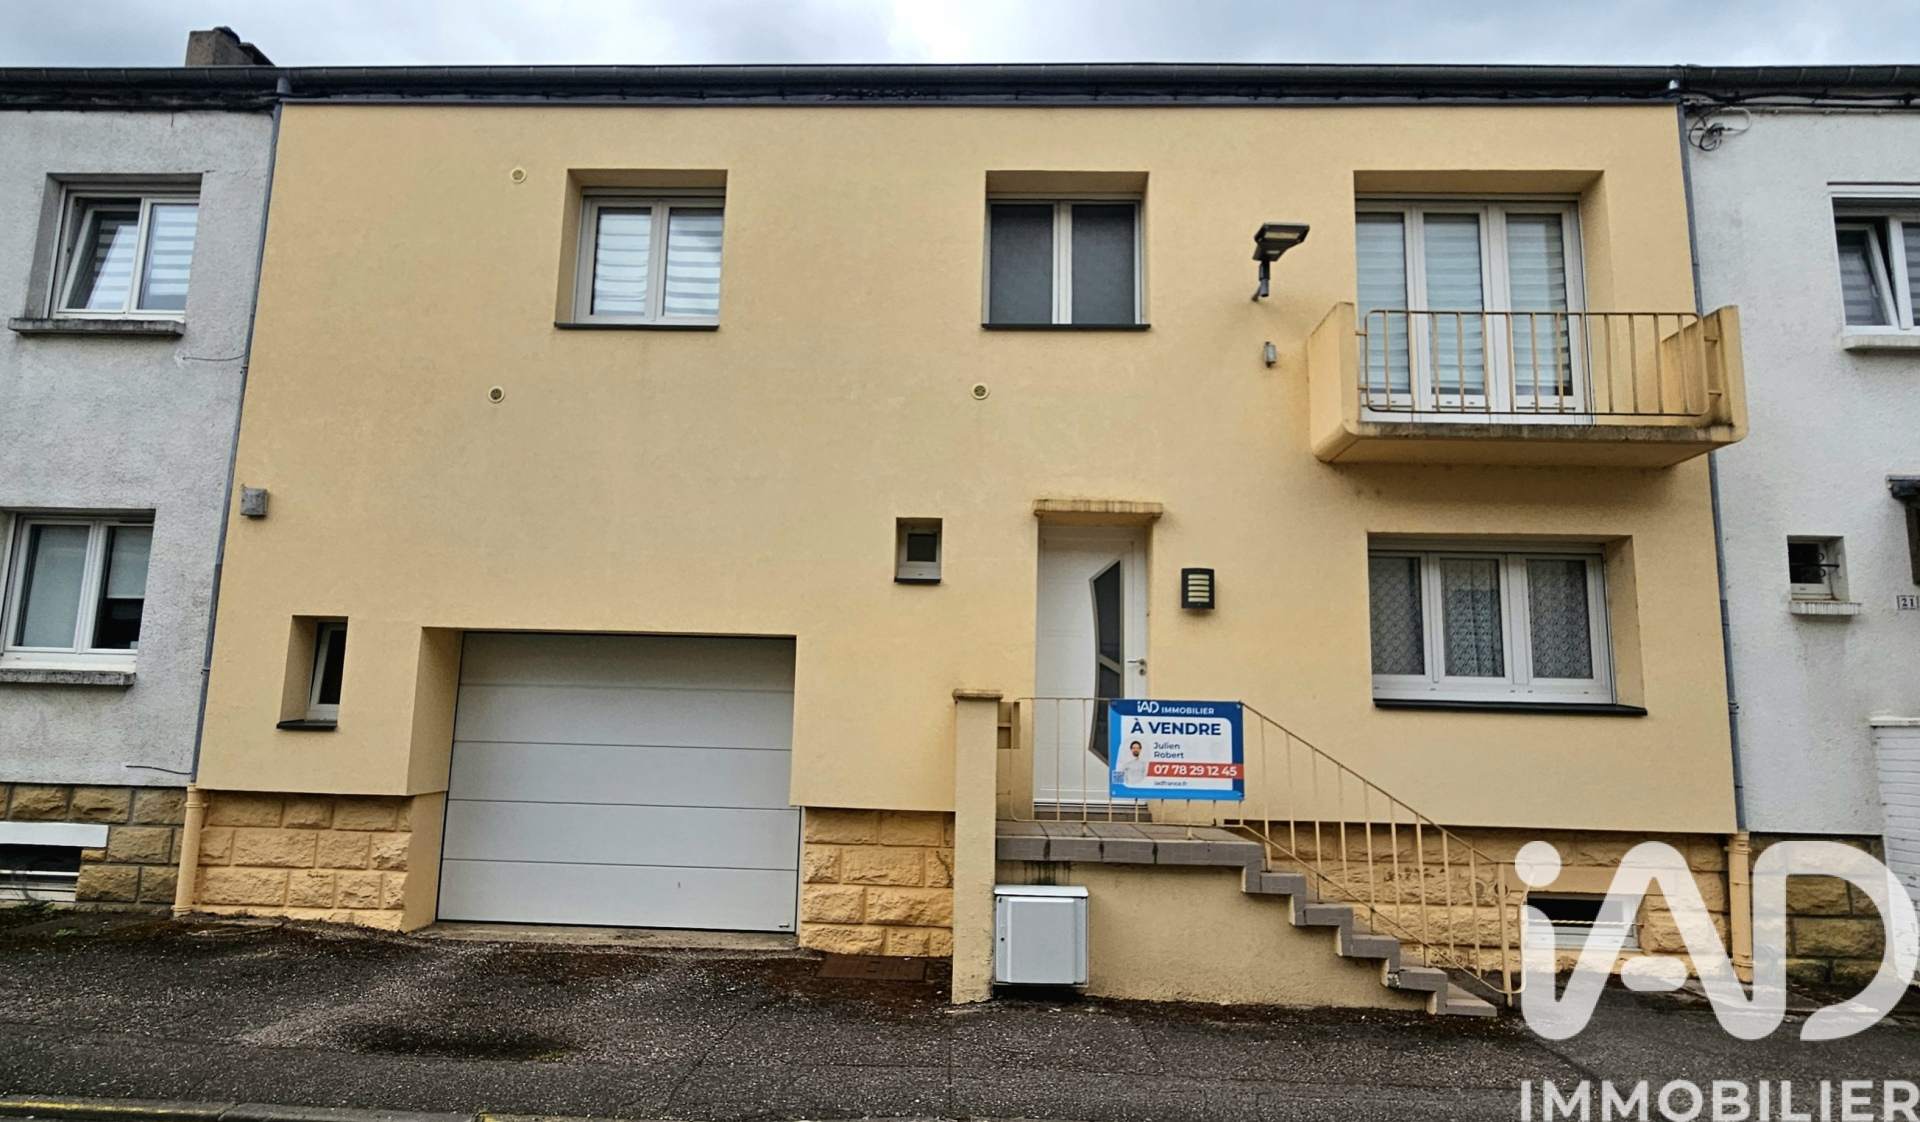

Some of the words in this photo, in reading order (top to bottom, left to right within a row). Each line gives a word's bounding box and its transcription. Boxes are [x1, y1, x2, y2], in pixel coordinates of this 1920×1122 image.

[1901, 597, 1914, 607] 21
[1161, 707, 1215, 715] IMMOBILIER
[1130, 718, 1144, 734] À
[1148, 721, 1222, 736] VENDRE
[1153, 742, 1180, 750] Julien
[1153, 751, 1185, 759] Robert
[1153, 764, 1169, 775] 07
[1171, 765, 1187, 776] 78
[1189, 765, 1205, 776] 29
[1206, 766, 1220, 777] 12
[1221, 766, 1238, 777] 45
